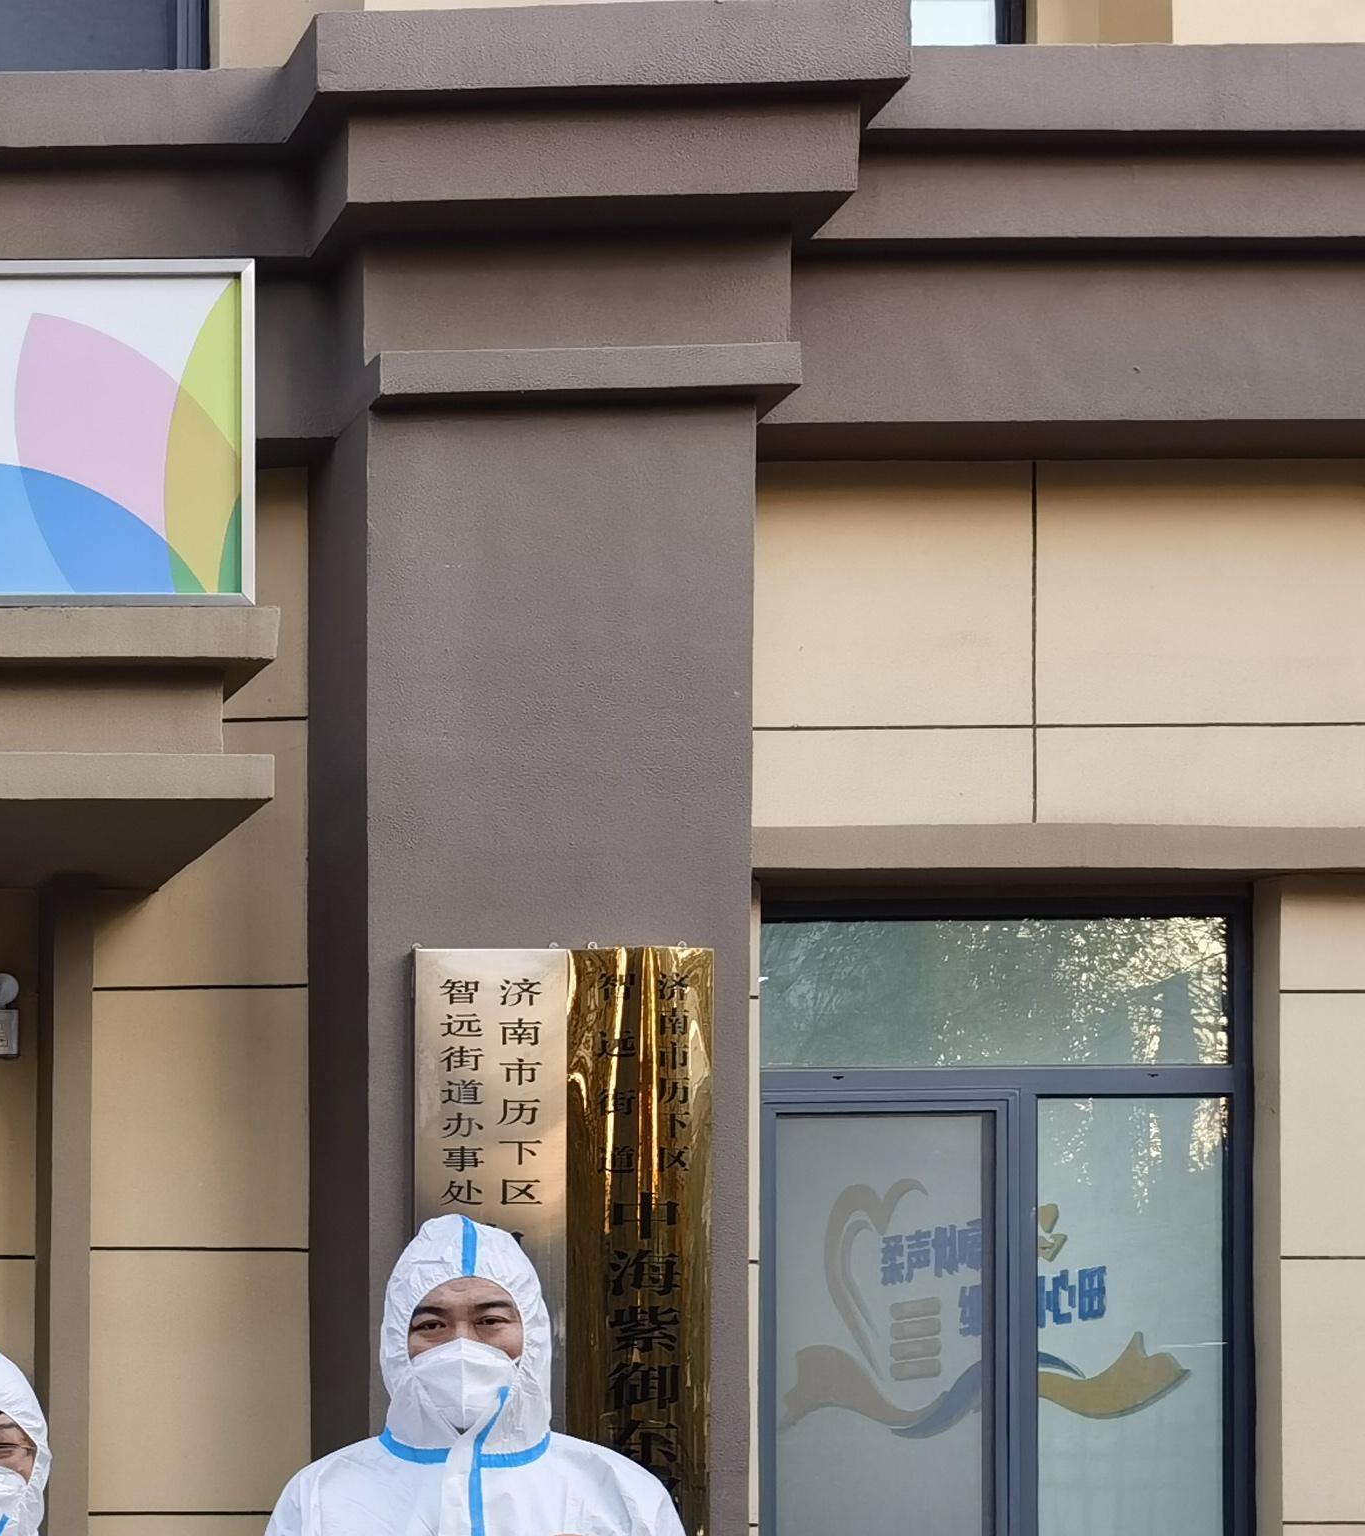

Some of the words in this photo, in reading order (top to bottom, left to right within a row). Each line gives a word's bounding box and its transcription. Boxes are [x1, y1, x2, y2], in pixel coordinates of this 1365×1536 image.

[439, 977, 485, 1206] 智远街道办事处
[495, 977, 543, 1206] 济南市历下区
